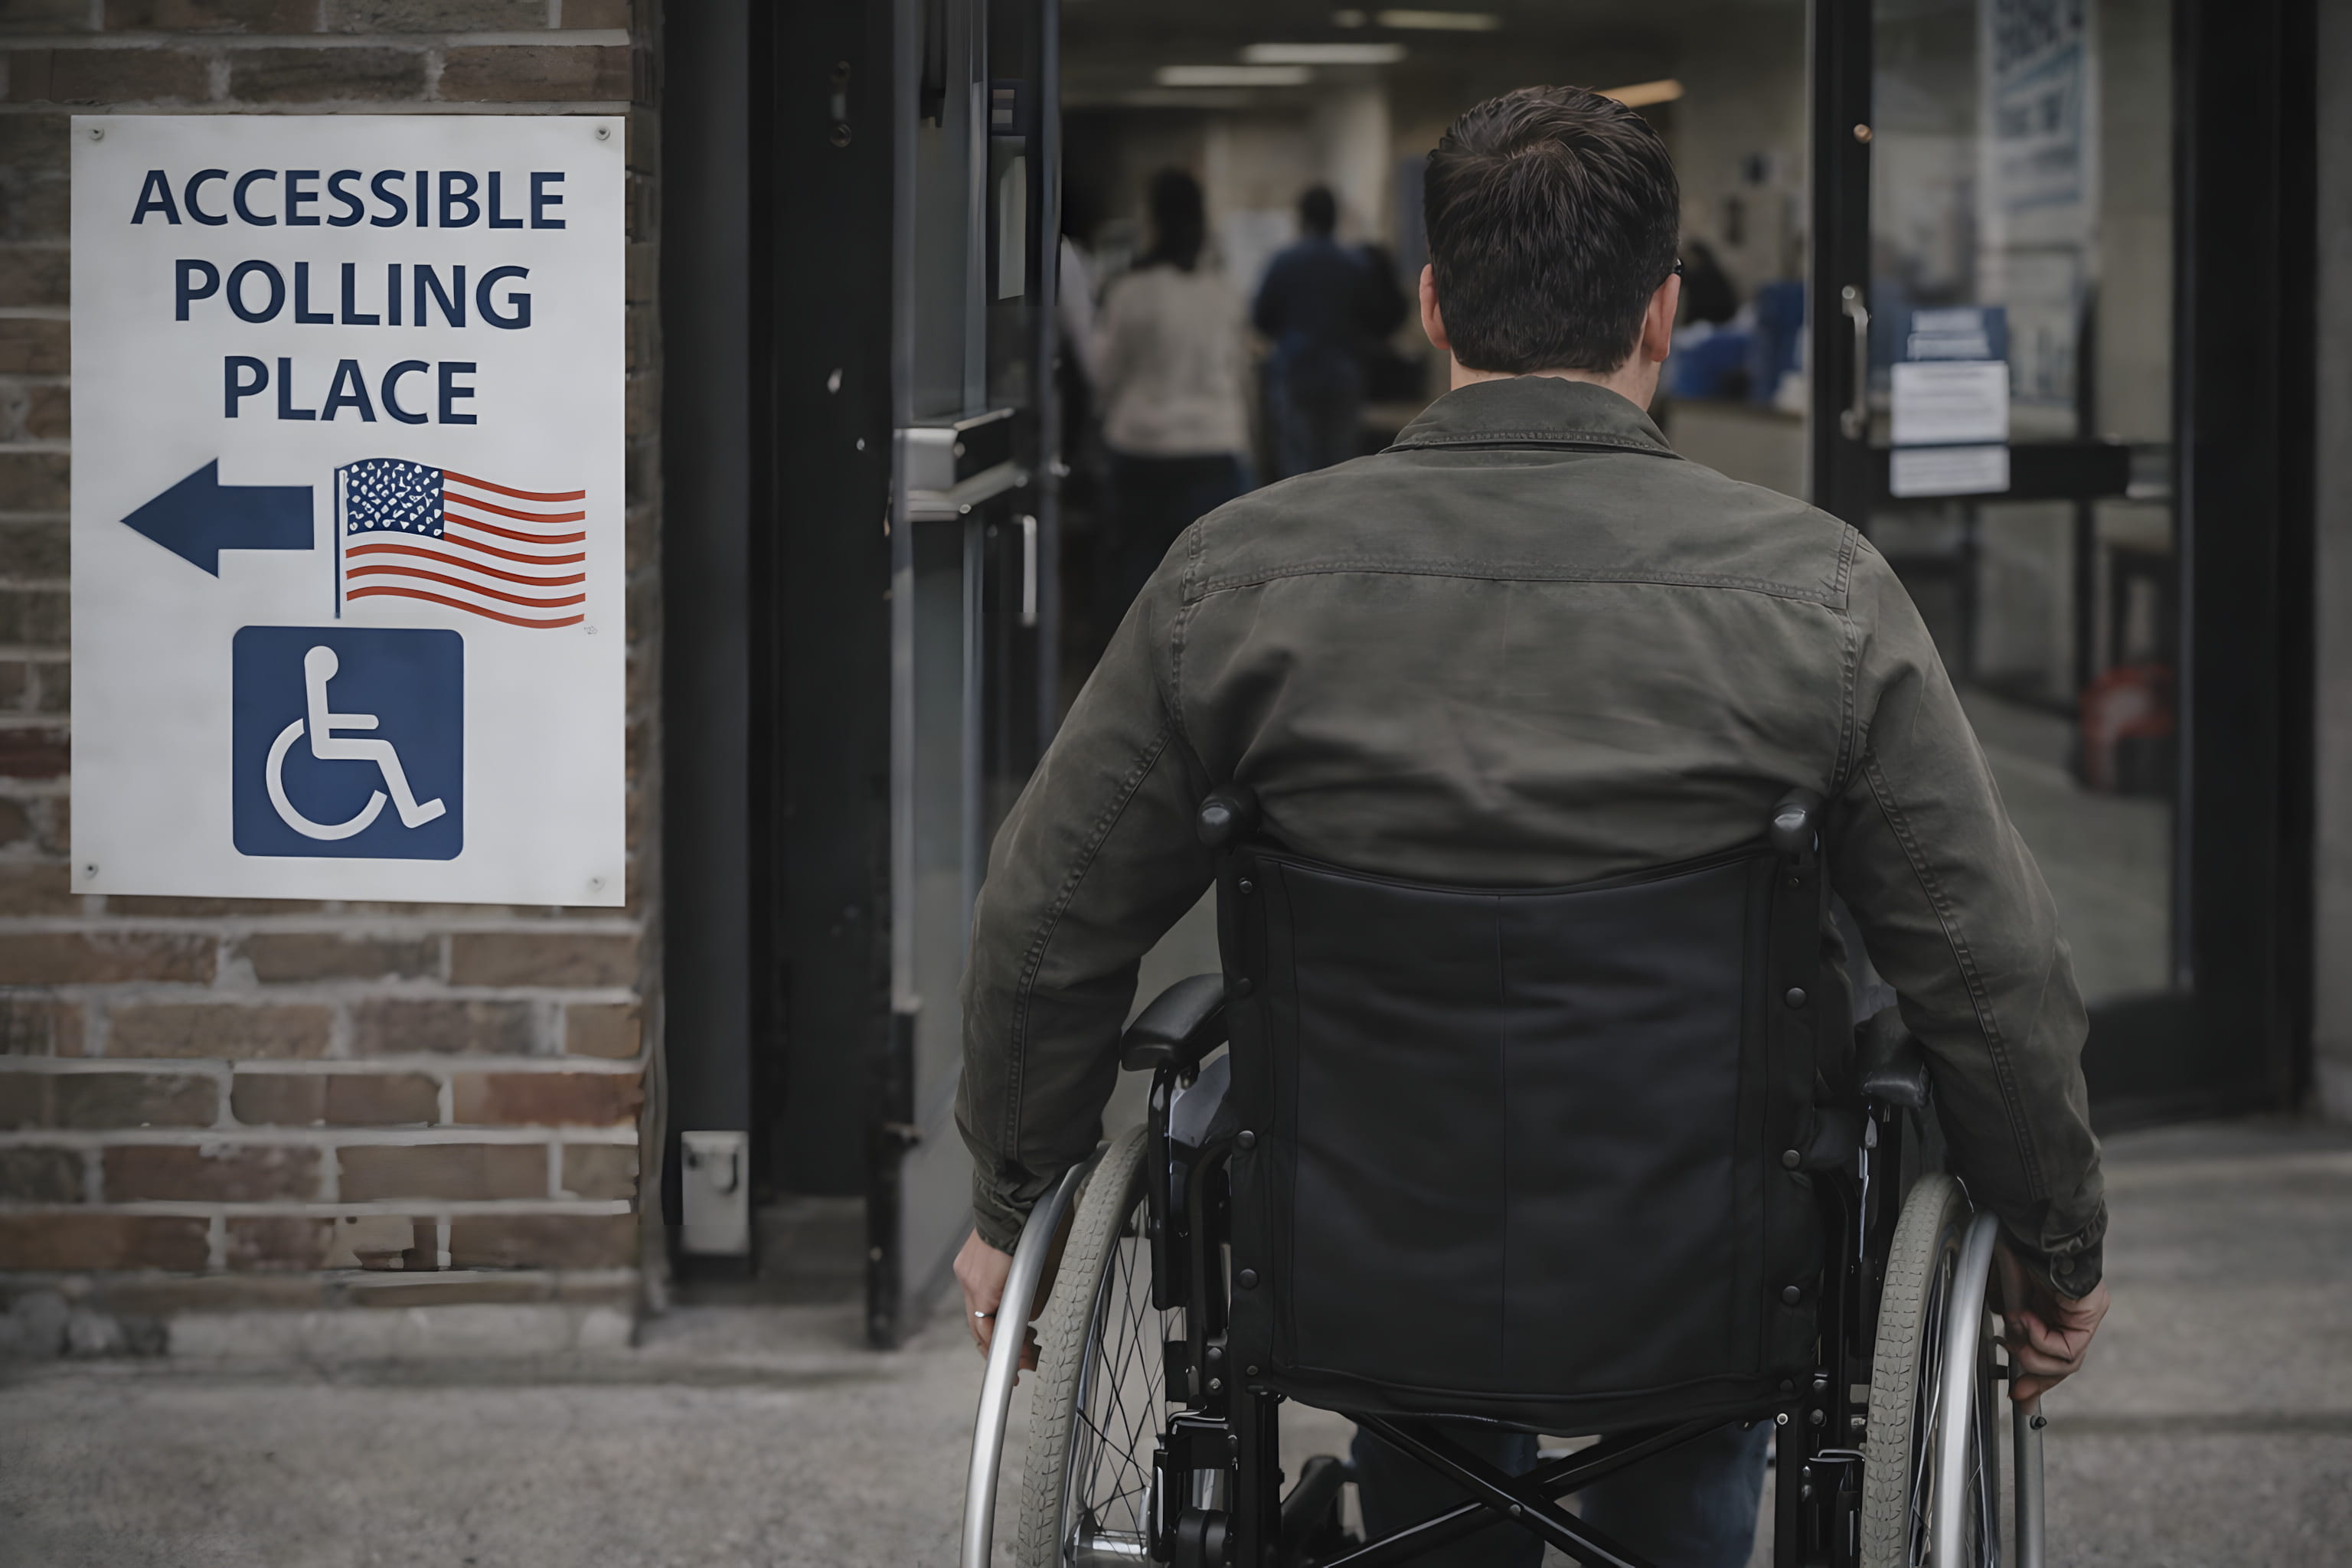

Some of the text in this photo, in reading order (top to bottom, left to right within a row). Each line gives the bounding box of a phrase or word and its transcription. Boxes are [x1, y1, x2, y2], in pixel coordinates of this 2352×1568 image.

[130, 168, 566, 230] ACCESSIBLE
[175, 259, 531, 330] POLLING
[224, 355, 478, 425] PLACE
